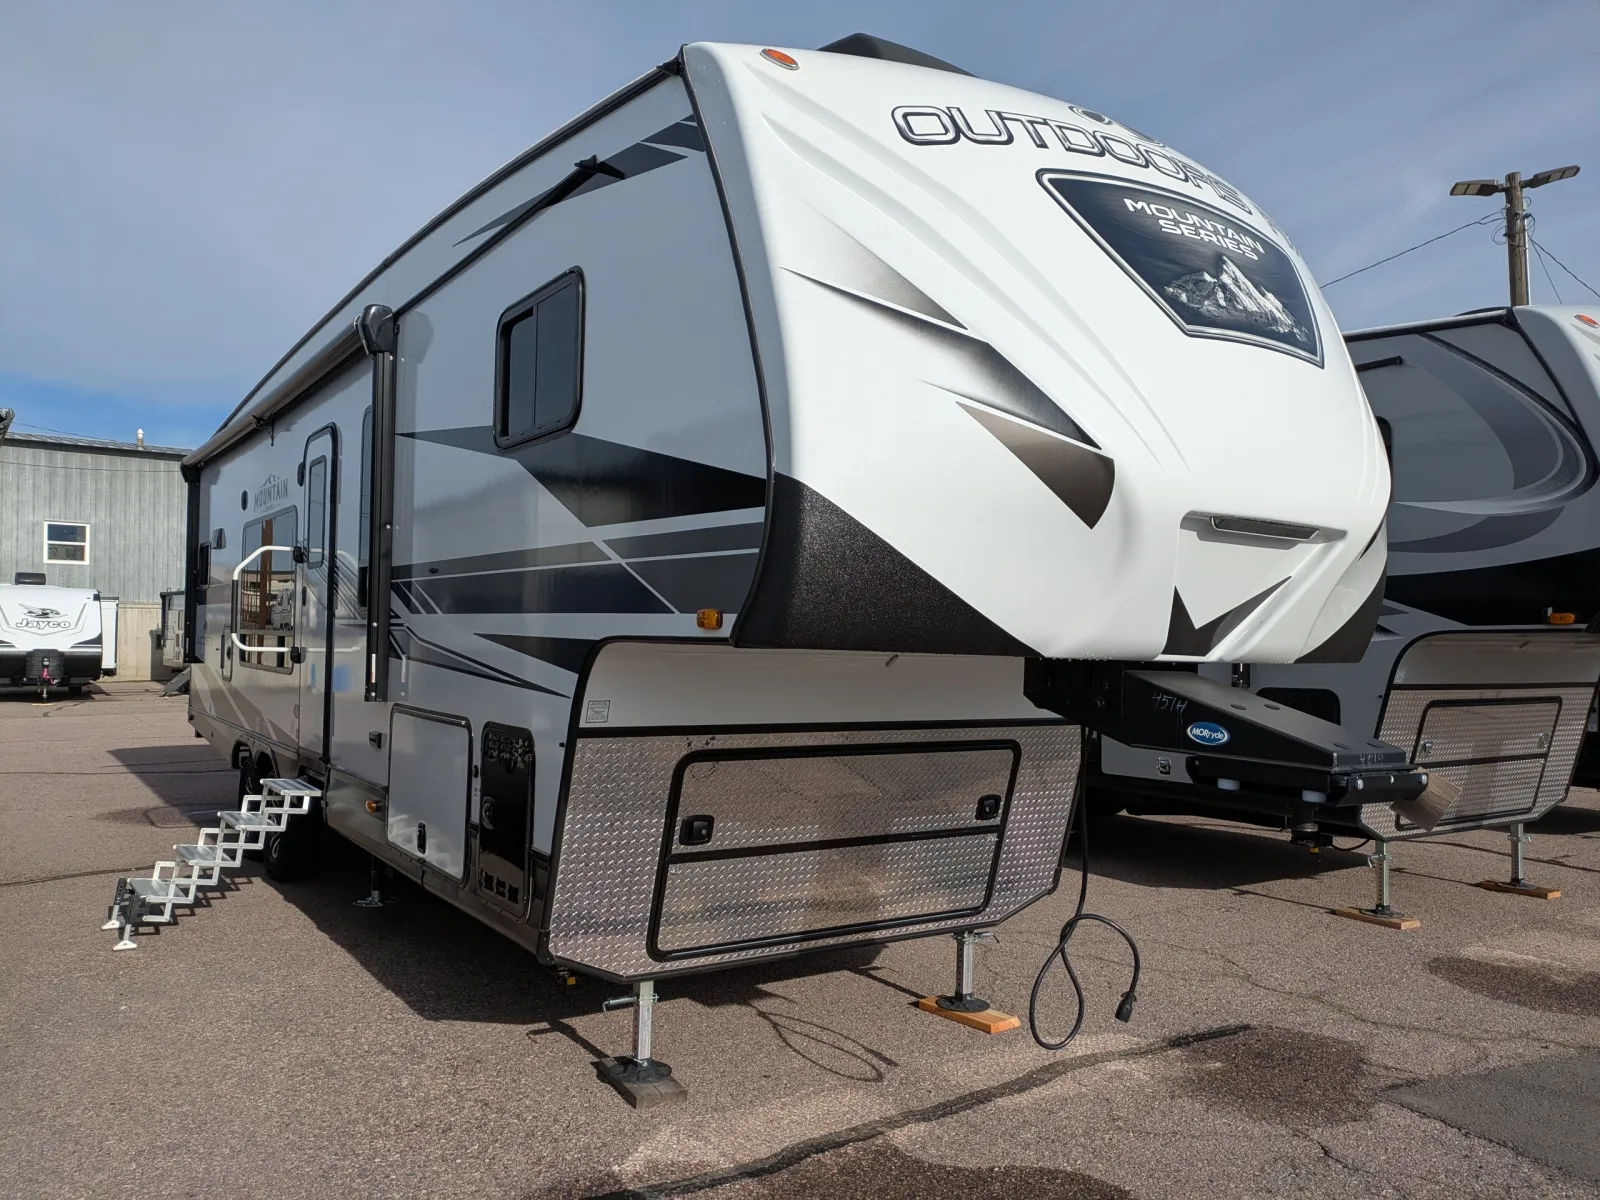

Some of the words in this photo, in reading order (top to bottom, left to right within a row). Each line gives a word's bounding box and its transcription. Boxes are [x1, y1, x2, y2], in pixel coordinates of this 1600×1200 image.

[891, 105, 1252, 215] OUTDOORS
[1123, 198, 1264, 254] MOUNTAIN
[1160, 218, 1258, 261] SERIES
[254, 478, 288, 512] MOUNTAIN
[16, 618, 71, 630] Jayco
[1191, 727, 1224, 740] MORryde
